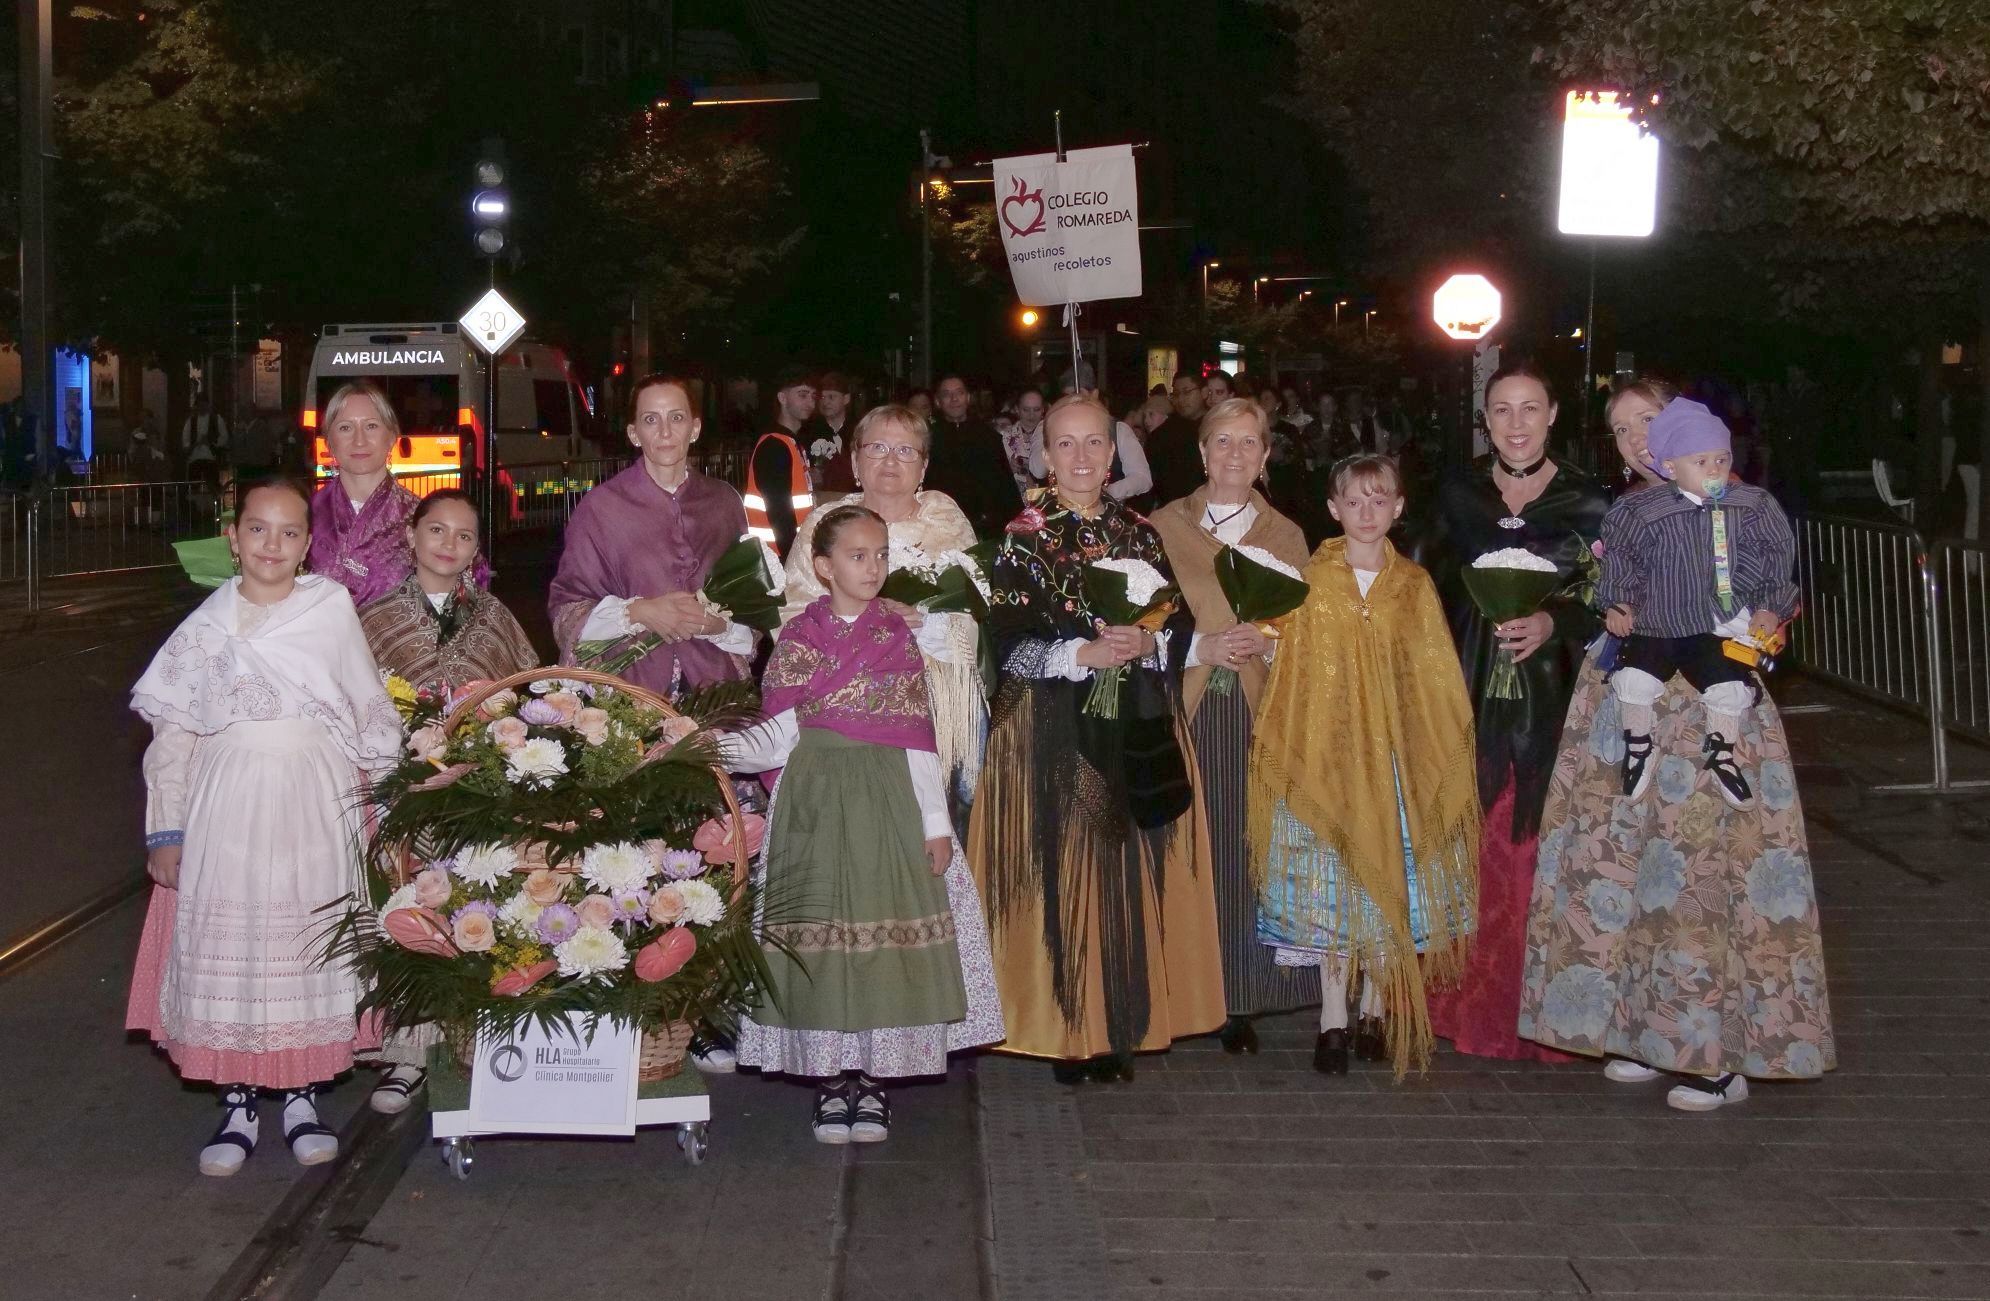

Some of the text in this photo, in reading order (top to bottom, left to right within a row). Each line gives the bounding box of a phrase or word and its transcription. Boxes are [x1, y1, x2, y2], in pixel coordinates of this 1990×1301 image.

[1048, 192, 1108, 210] COLEGIO
[1057, 209, 1133, 228] ROMAREDA
[1012, 246, 1065, 264] agustinos
[1053, 256, 1112, 272] recoletos
[479, 311, 507, 332] 30
[332, 350, 445, 365] AMBULANCIA
[535, 1047, 581, 1064] HLA Grupo
[566, 1071, 614, 1083] Montpellier
